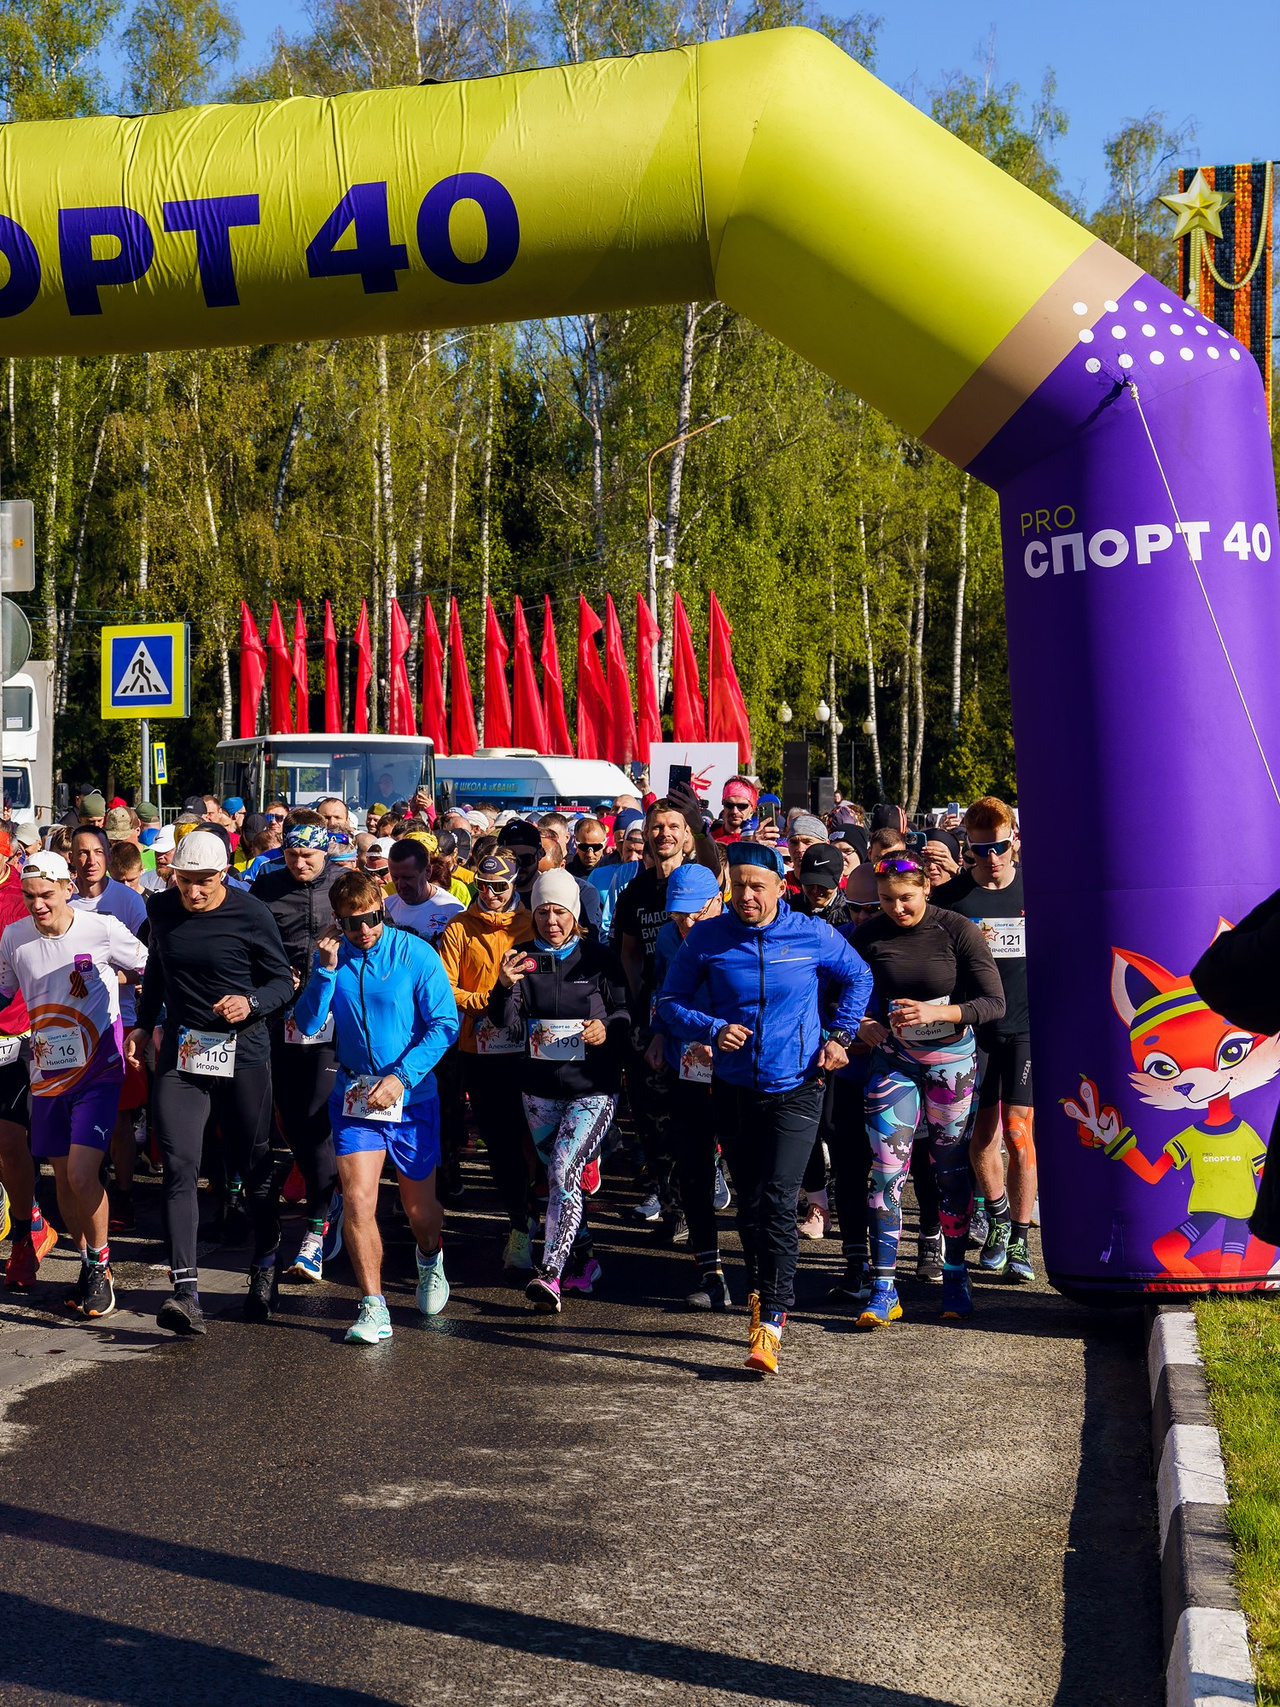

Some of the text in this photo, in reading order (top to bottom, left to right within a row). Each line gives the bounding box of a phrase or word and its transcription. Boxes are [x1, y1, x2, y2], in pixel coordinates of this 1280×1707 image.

[305, 172, 520, 294] 40
[1020, 504, 1076, 537] PRO
[1024, 521, 1271, 578] СПОРТ 40
[460, 782, 487, 791] ШКОЛА
[1000, 934, 1020, 945] 121
[554, 1037, 579, 1048] 190
[58, 1045, 75, 1056] 16
[46, 1057, 77, 1066] Николай
[204, 1051, 228, 1063] 110
[196, 1062, 219, 1071] Игорь
